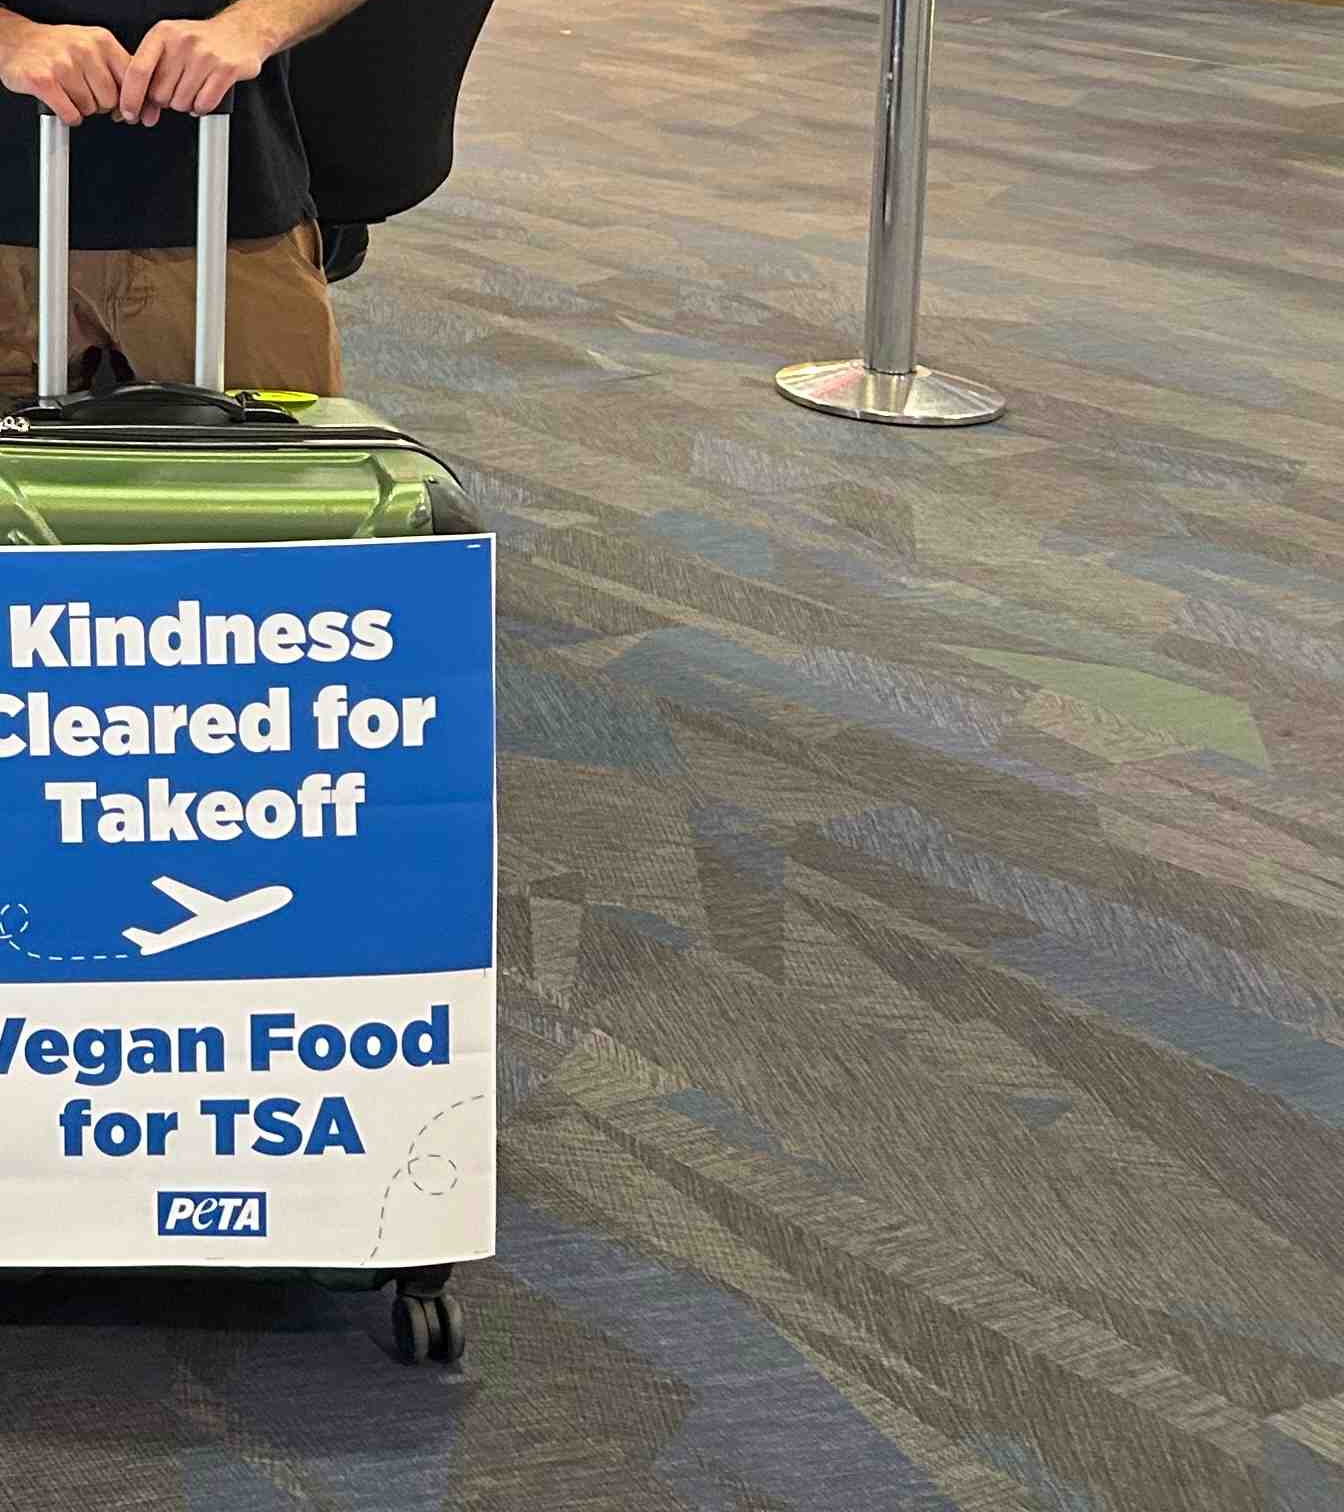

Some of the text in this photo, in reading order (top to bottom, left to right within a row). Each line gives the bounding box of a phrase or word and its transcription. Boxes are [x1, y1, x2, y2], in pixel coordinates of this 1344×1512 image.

[9, 600, 394, 669] Kindness
[312, 685, 436, 751] for
[45, 772, 365, 844] Takeoff
[249, 1004, 451, 1072] Food
[59, 1096, 365, 1157] for TSA
[165, 1197, 261, 1232] PeTA
